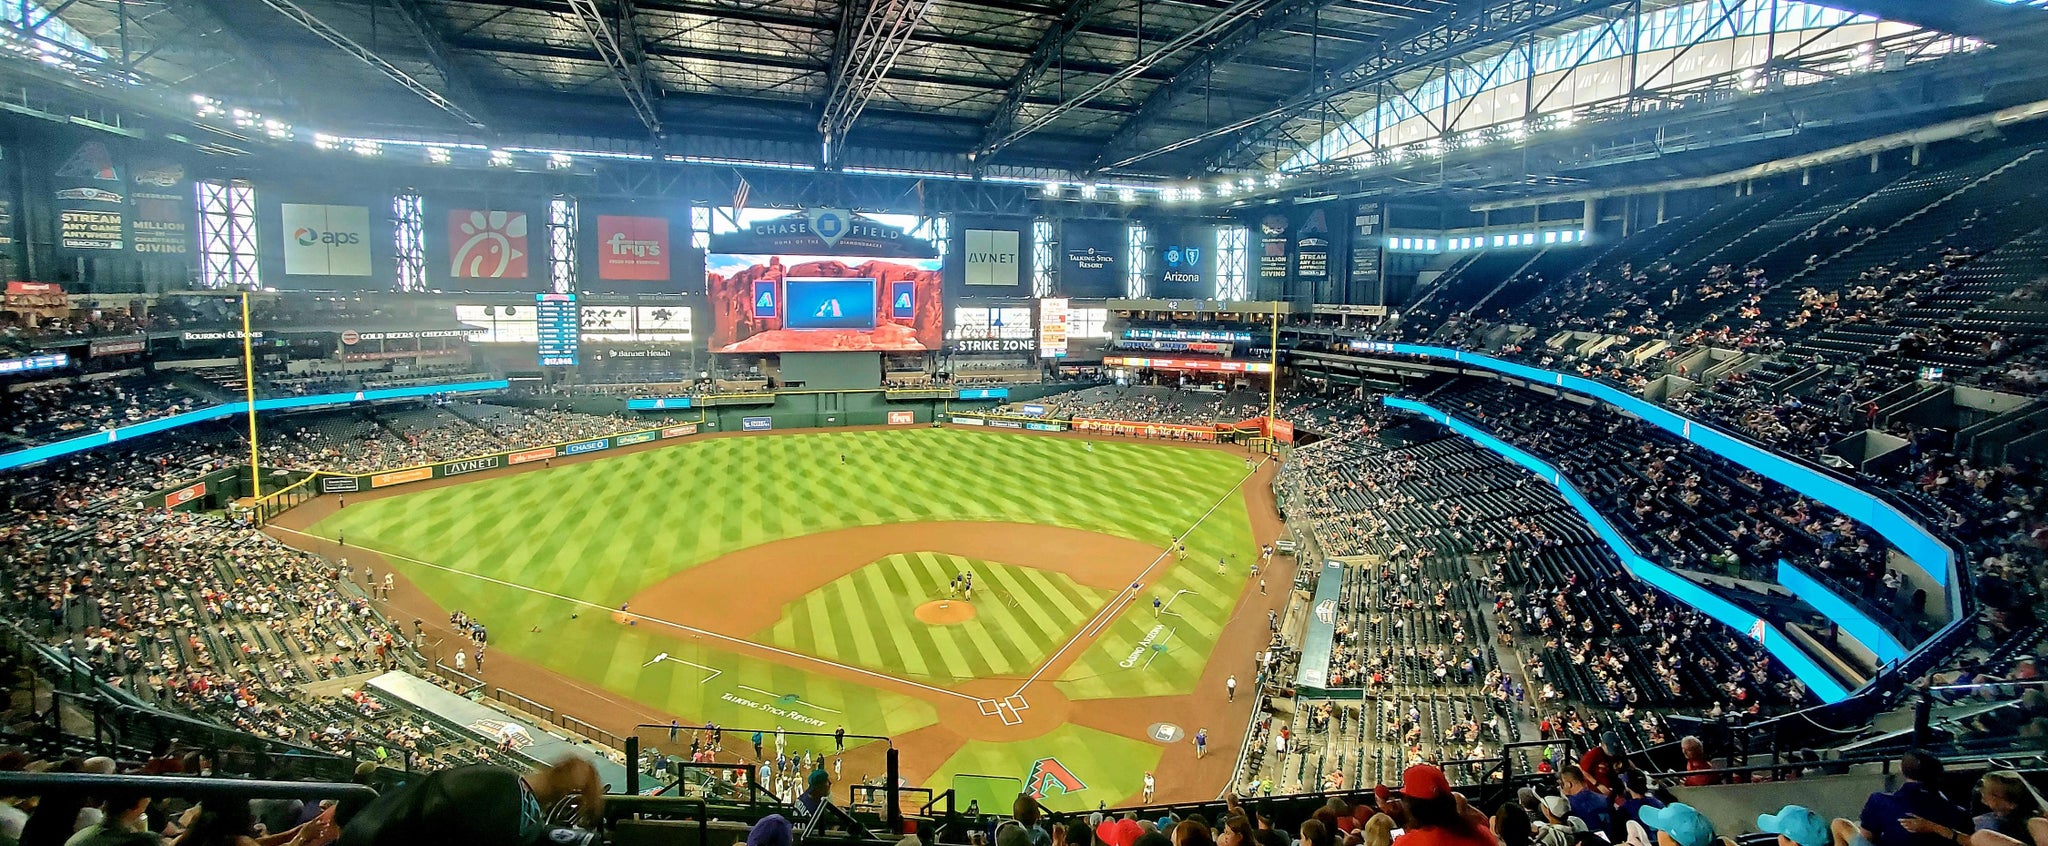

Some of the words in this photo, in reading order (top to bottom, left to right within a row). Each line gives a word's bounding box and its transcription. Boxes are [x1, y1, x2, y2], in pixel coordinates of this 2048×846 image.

[61, 214, 121, 224] STREAM
[62, 223, 88, 231] ANY
[90, 224, 122, 232] GAME
[133, 221, 185, 231] MILLION
[756, 223, 806, 235] CHASE
[852, 225, 899, 239] FIELD
[62, 231, 122, 239] ANYWHERE
[321, 231, 360, 247] aps
[135, 244, 187, 253] GIVING
[606, 232, 660, 257] fry's
[839, 240, 883, 248] DIAMONDBACKS
[968, 253, 1016, 264] AVNET
[1163, 271, 1200, 282] Arizona
[1168, 301, 1178, 309] 42
[184, 332, 226, 340] BOURBON
[959, 340, 1000, 351] STRIKE
[1002, 340, 1036, 351] ZONE
[646, 349, 671, 357] Health
[571, 441, 597, 452] CHASE
[451, 458, 493, 472] AVNET
[720, 692, 759, 709] TALKING
[759, 703, 787, 717] STICK
[786, 710, 827, 728] RESORT
